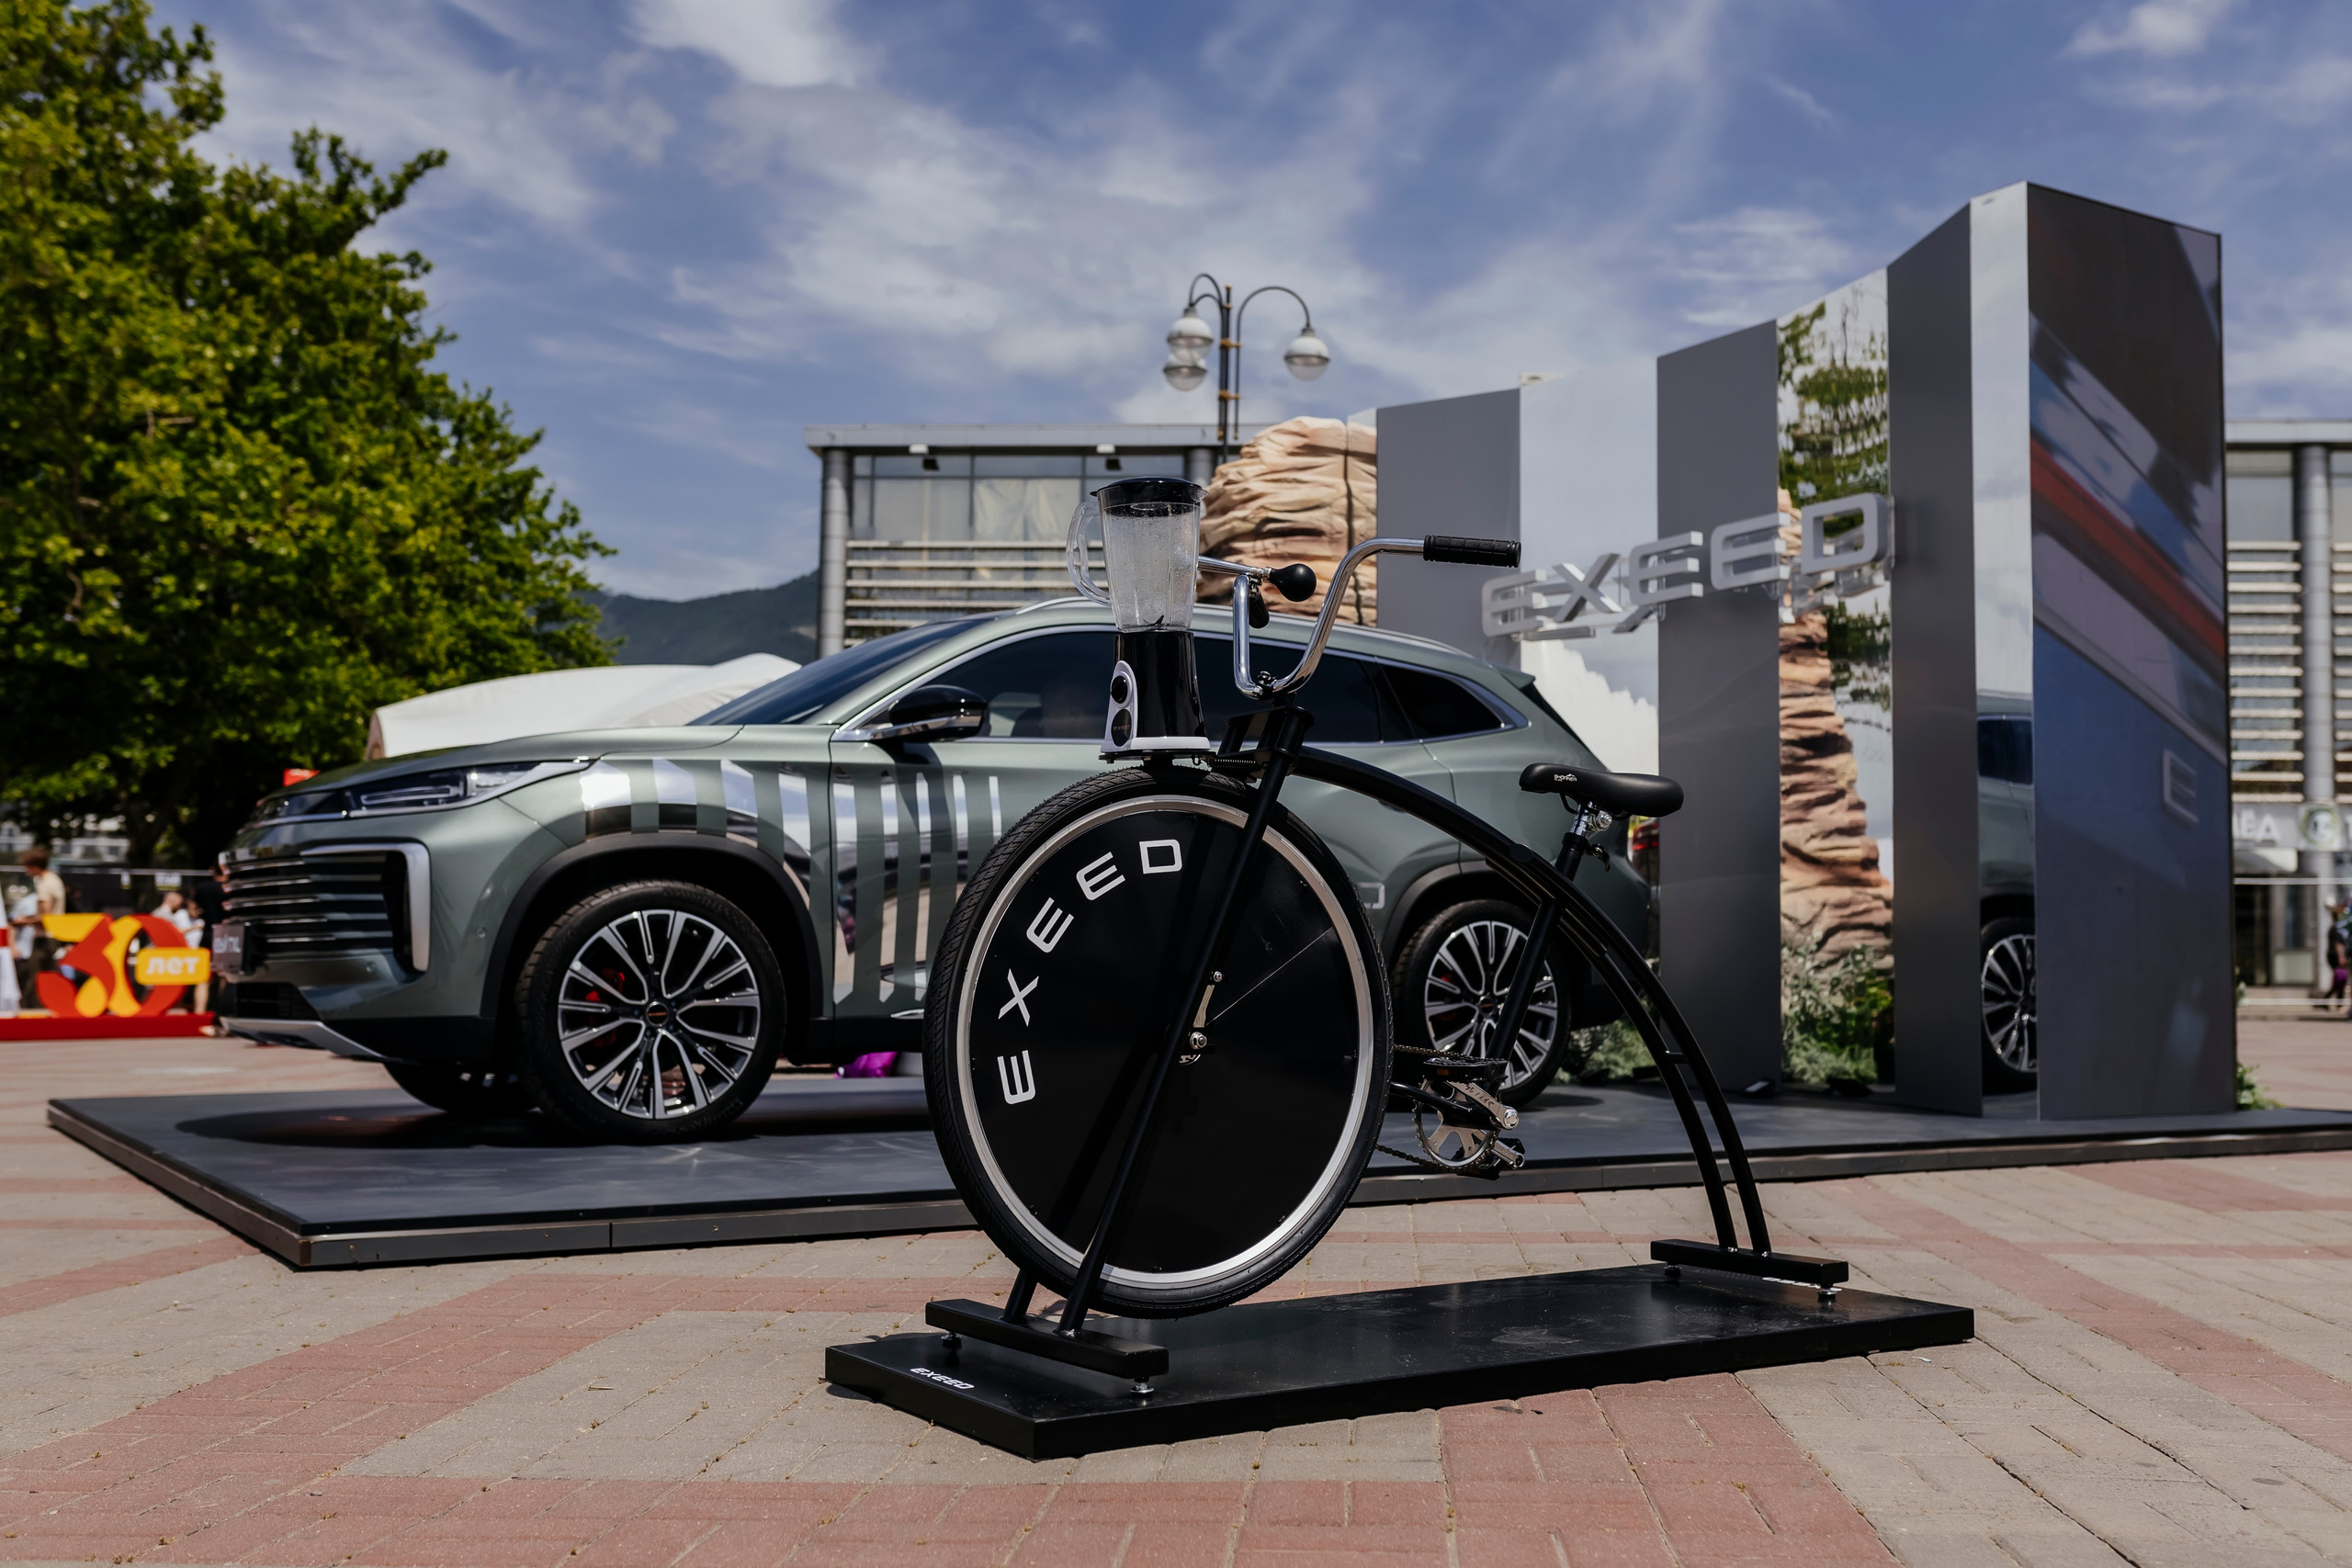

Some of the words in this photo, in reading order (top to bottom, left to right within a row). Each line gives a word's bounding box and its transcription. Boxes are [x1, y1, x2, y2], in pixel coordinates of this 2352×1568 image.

[1482, 492, 1886, 637] EXEED
[146, 956, 199, 976] лет
[998, 840, 1182, 1105] EXEED
[910, 1368, 974, 1389] EXEED
